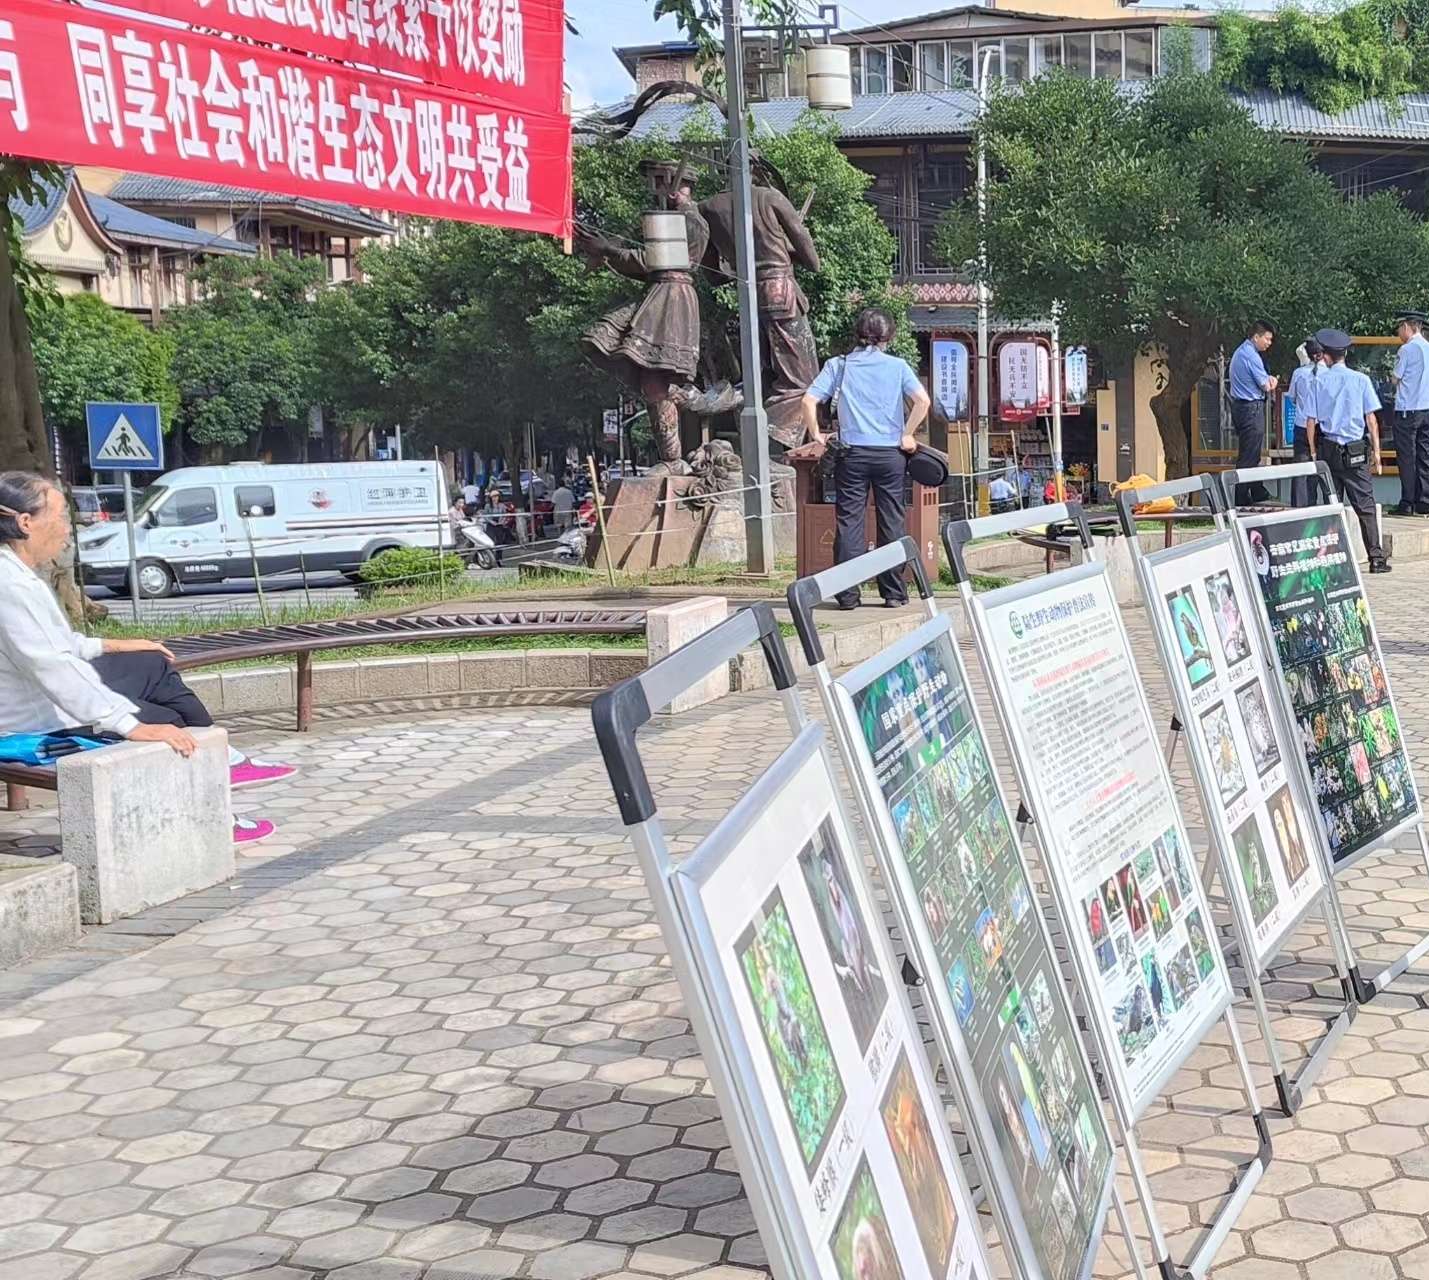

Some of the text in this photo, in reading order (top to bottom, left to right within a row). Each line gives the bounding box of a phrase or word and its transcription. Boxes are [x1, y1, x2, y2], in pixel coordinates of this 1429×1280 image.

[66, 21, 531, 214] 同享社会和谐生态文明共受益
